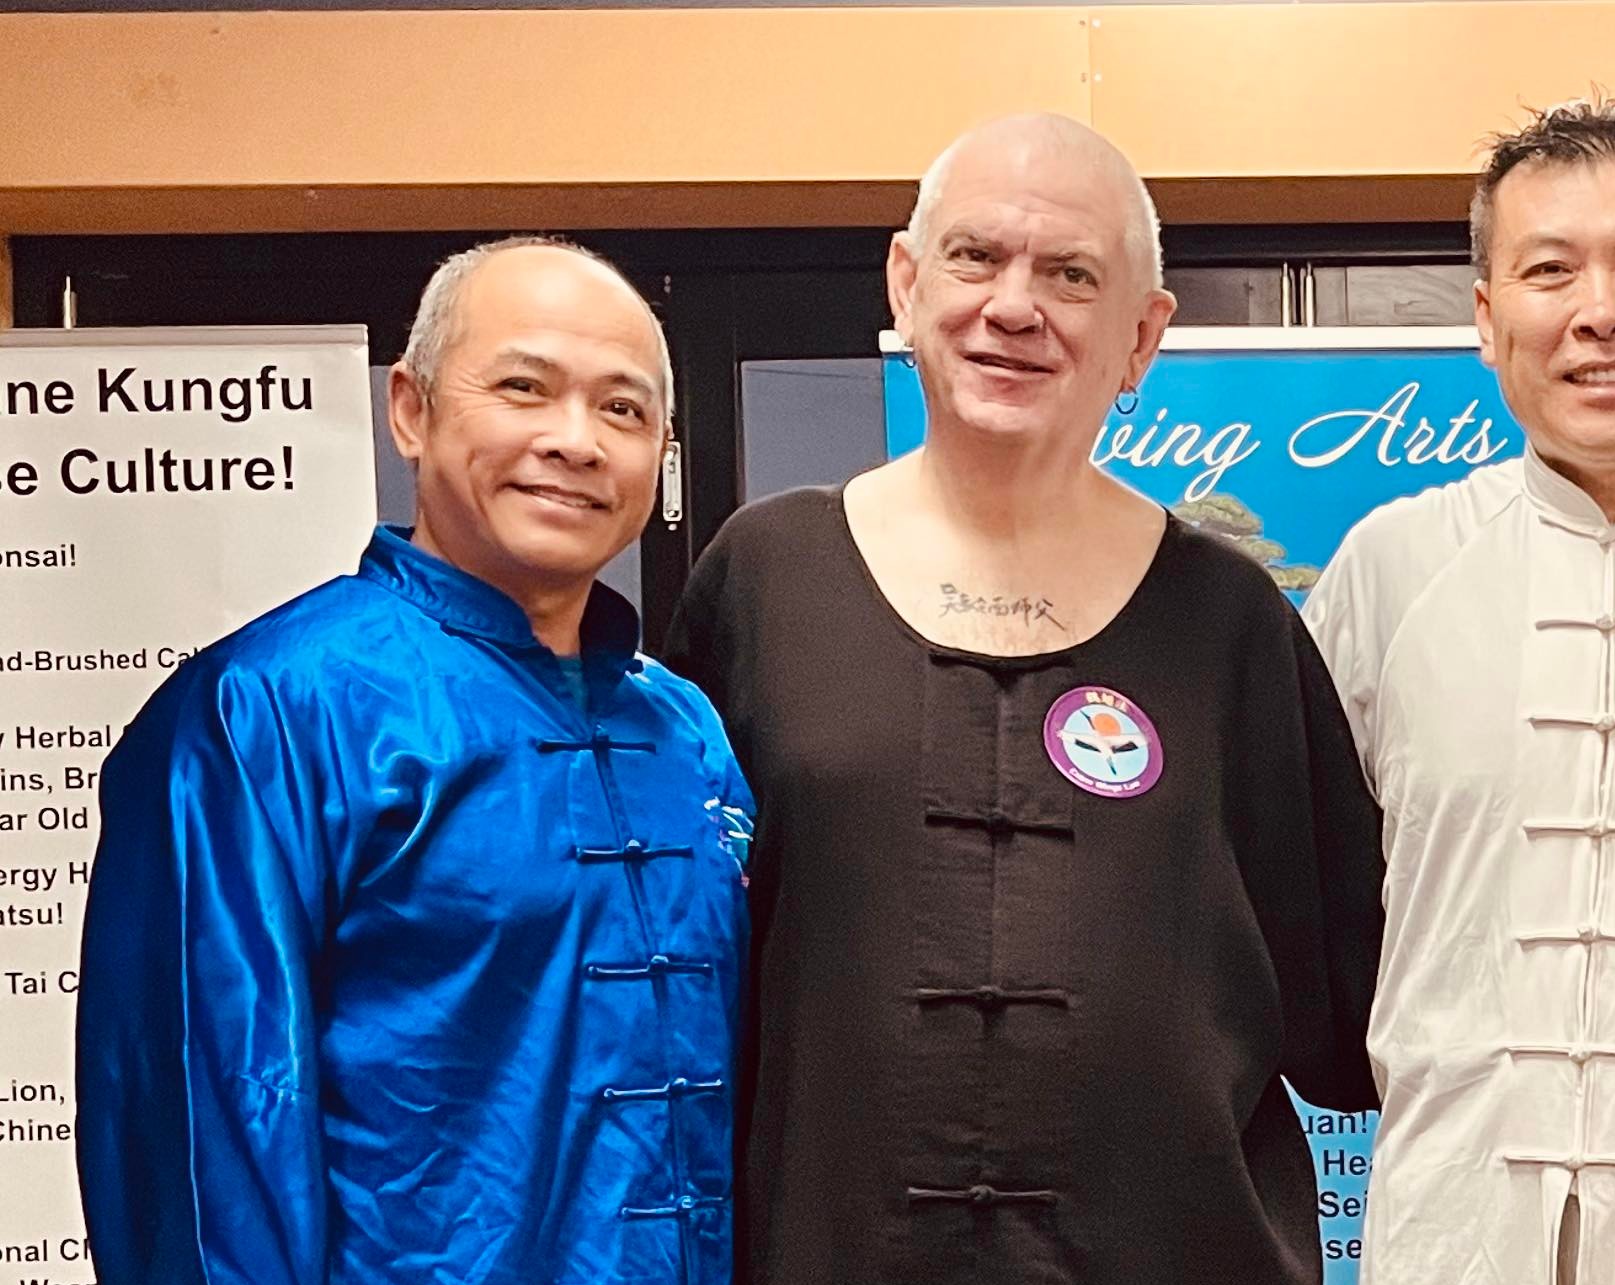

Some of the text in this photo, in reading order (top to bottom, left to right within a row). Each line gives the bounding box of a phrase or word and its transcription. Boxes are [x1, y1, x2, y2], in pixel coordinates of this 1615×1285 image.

[98, 365, 313, 423] Kungfu
[1287, 382, 1508, 468] Arts
[61, 446, 294, 495] Culture!
[157, 646, 198, 669] Ca
[16, 724, 111, 749] Herbal
[64, 767, 98, 789] Br
[38, 807, 88, 831] Old
[4, 971, 46, 994] Tai
[1323, 1149, 1373, 1176] He
